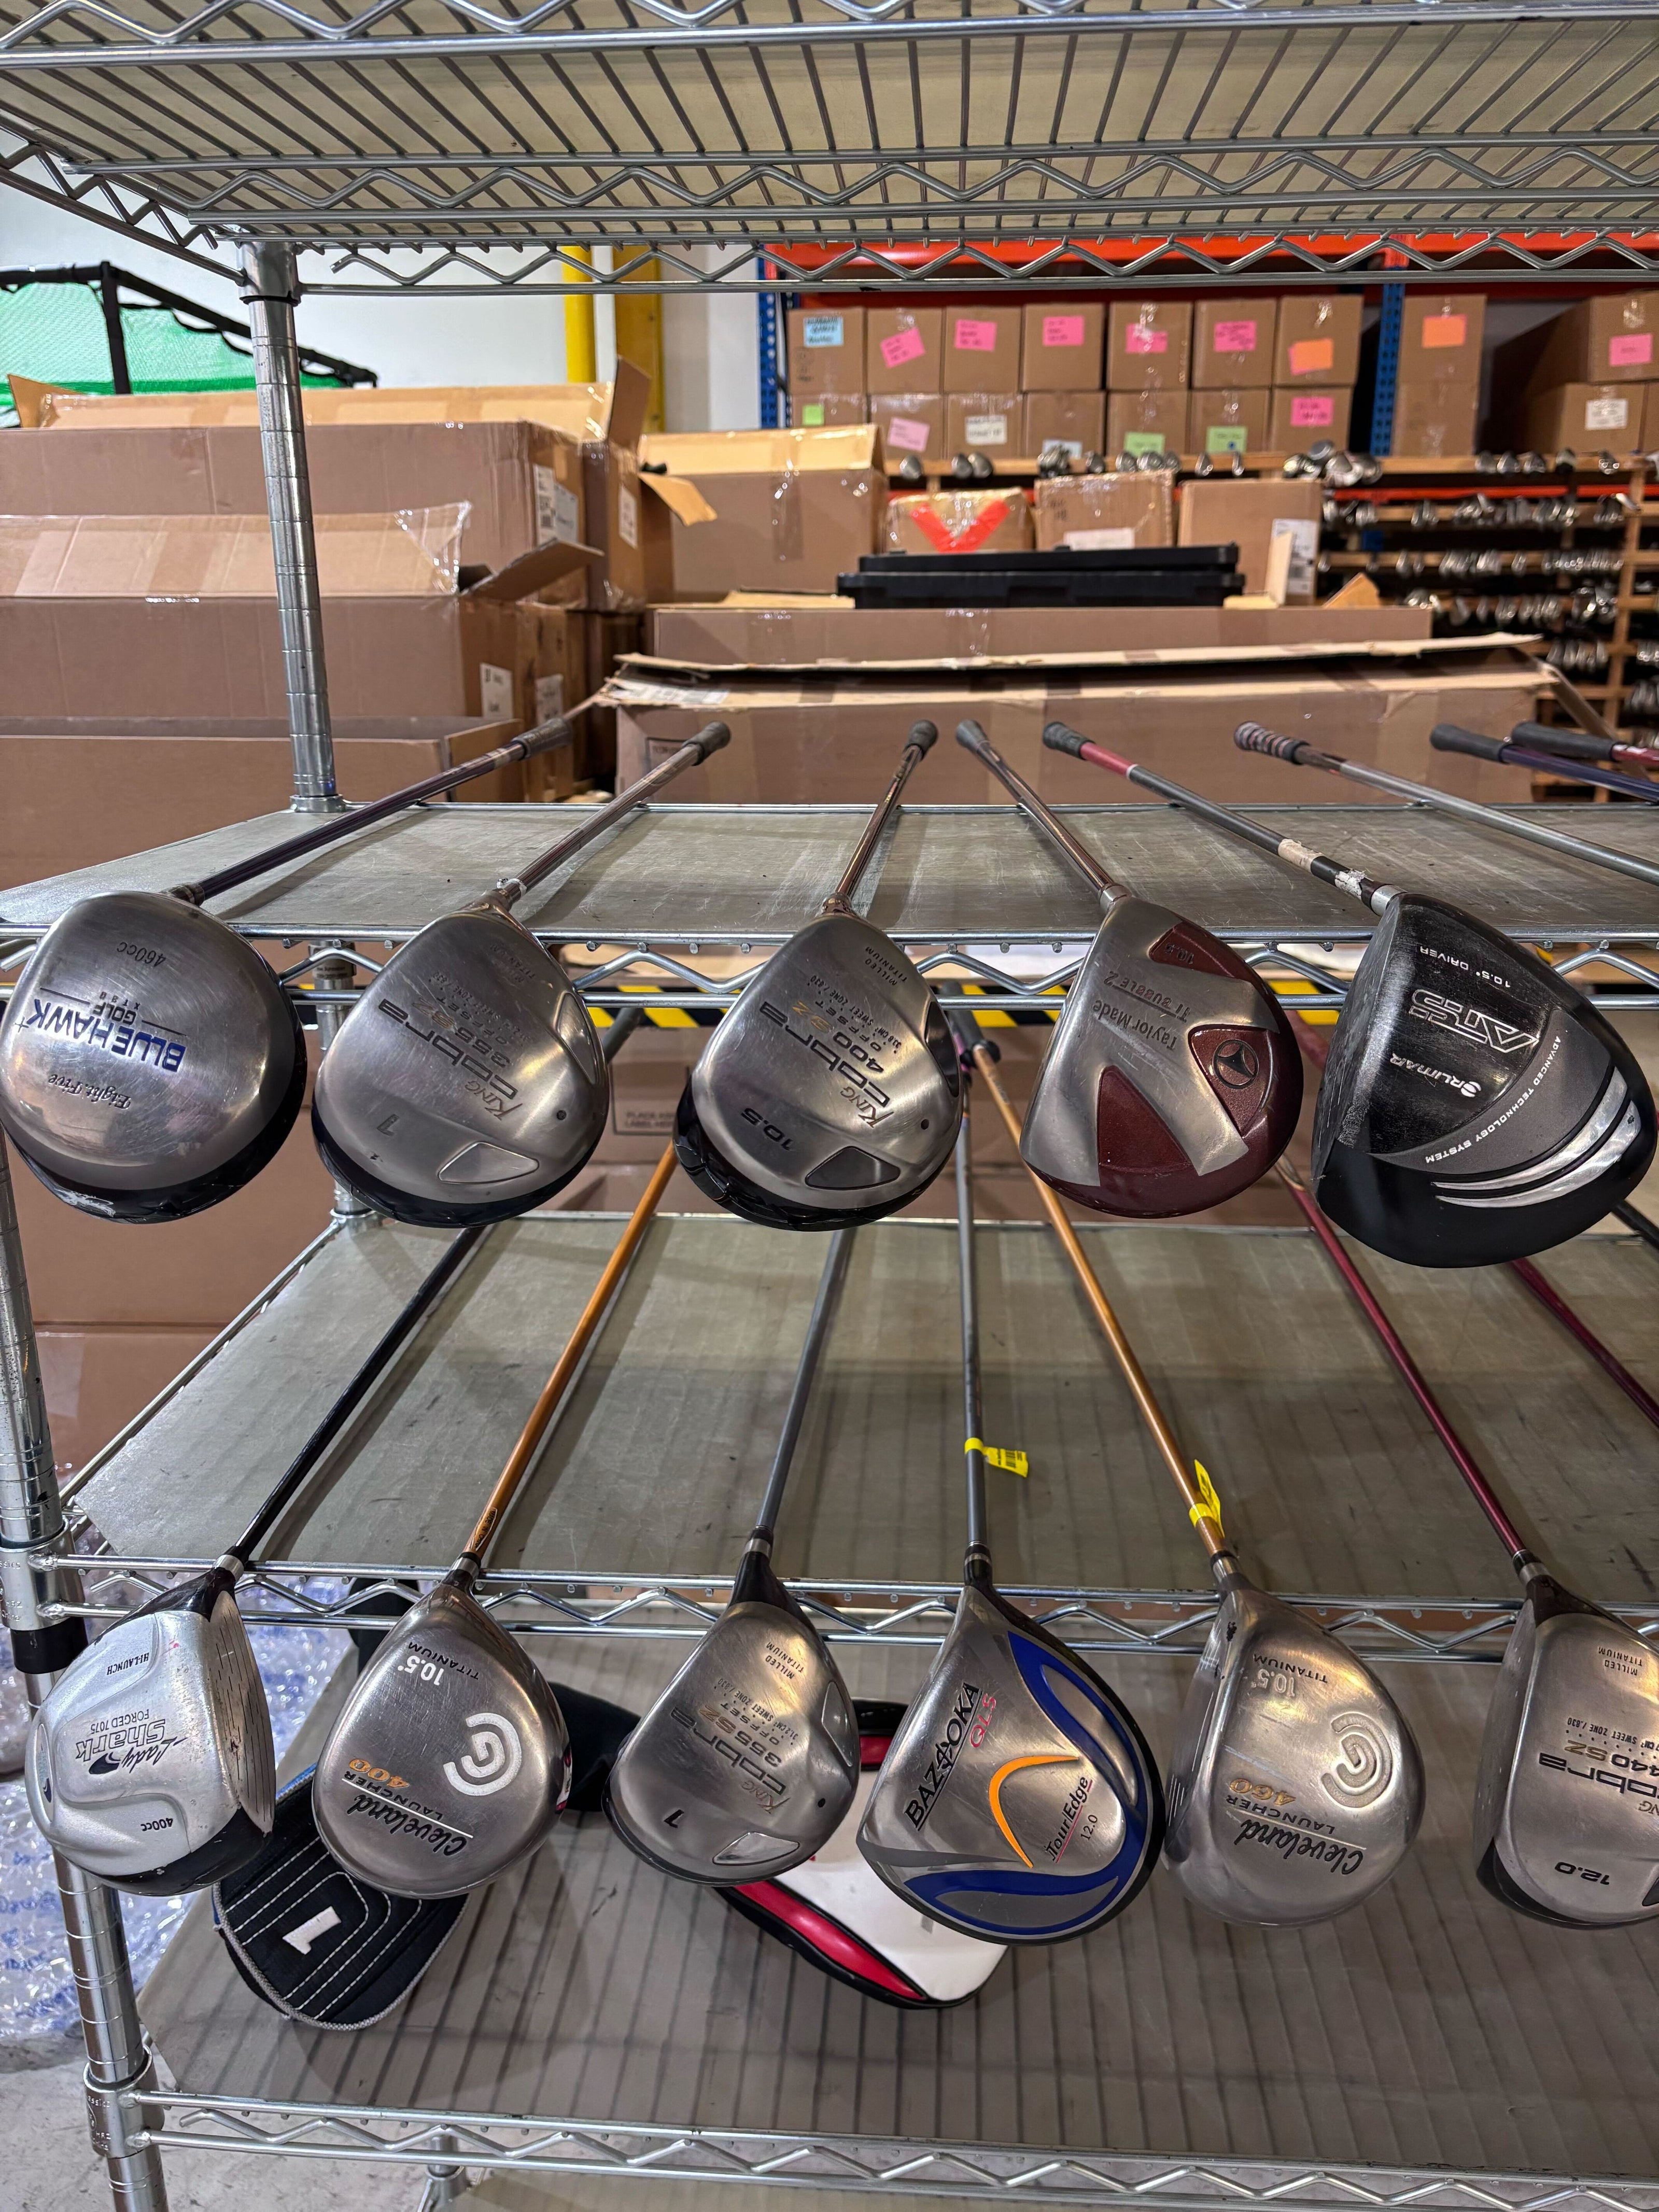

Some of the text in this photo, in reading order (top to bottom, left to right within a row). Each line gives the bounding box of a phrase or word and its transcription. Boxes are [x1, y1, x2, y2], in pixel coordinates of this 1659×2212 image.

[116, 941, 166, 967] 460cc
[865, 947, 907, 982] TITANIUM
[865, 958, 897, 985] MILLED
[1420, 946, 1469, 969] DRIVER
[1104, 970, 1119, 986] 2
[1119, 978, 1173, 1009] BUBBLE
[93, 1003, 137, 1024] GOLF
[830, 990, 848, 1006] ZONE
[849, 1006, 874, 1025] SWEET
[413, 997, 512, 1068] 355 SZ
[437, 996, 508, 1045] OFFSET
[791, 1001, 884, 1073] 400 SZ
[816, 999, 881, 1052] OFFSET
[1409, 989, 1539, 1054] ATS
[378, 998, 519, 1100] cobra
[760, 1002, 890, 1107] cobra
[465, 1078, 523, 1121] KING
[840, 1086, 894, 1128] KING
[1425, 1035, 1561, 1164] ADVANCED TECHNOLOGY SYSTEM
[741, 1107, 794, 1151] 10.5
[407, 1642, 480, 1681] TITANIUM
[764, 1655, 795, 1679] MILLED
[766, 1641, 804, 1673] TITANIUM
[1253, 1653, 1328, 1683] TITANIUM
[1598, 1646, 1643, 1667] TITANIUM
[1604, 1659, 1638, 1675] MILLED
[735, 1690, 752, 1705] ZONE
[752, 1703, 774, 1722] SWEET
[90, 1709, 149, 1732] FORGED 7075
[699, 1704, 782, 1768] 355 SZ
[721, 1701, 780, 1745] OFFSET
[970, 1693, 996, 1748] QLS
[1589, 1723, 1608, 1736] ZONE
[1611, 1730, 1638, 1744] SWEET
[76, 1719, 166, 1761] Shark
[121, 1737, 188, 1774] Lady
[670, 1707, 787, 1796] cobra
[1564, 1739, 1659, 1775] 440 SZ
[349, 1758, 410, 1789] 400
[1539, 1752, 1659, 1797] obra
[343, 1770, 444, 1820] LAUNCHER
[1229, 1777, 1296, 1806] 460
[1638, 1800, 1659, 1816] NG
[140, 1817, 174, 1831] 400cc
[347, 1793, 467, 1857] Cleveland
[1080, 1813, 1098, 1841] 12.0
[1226, 1794, 1335, 1834] LAUNCHER
[1233, 1819, 1365, 1876] Cleveland
[1555, 1862, 1610, 1885] 12.0
